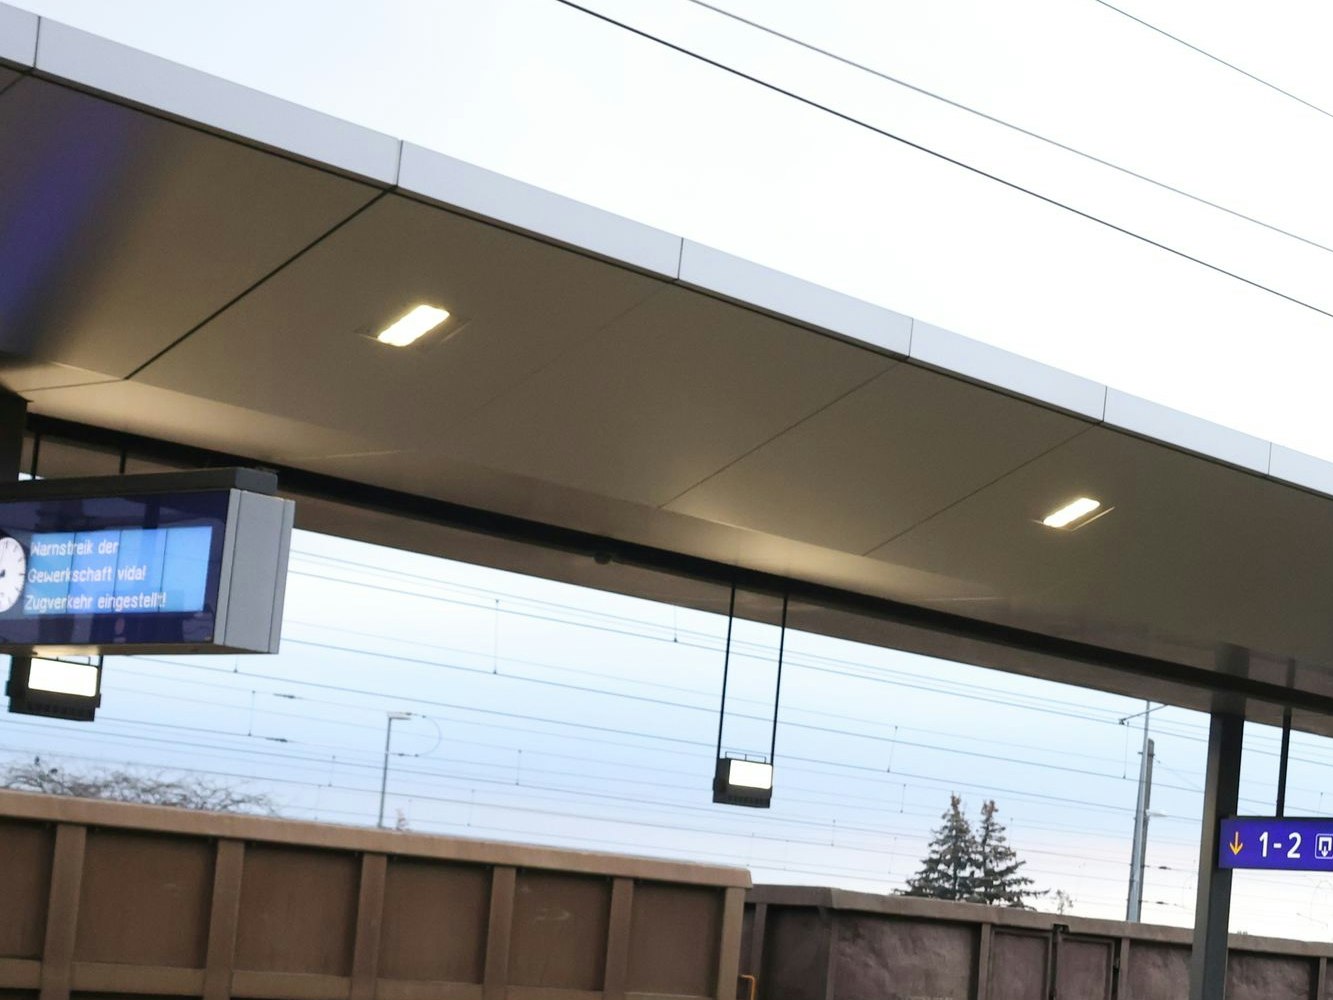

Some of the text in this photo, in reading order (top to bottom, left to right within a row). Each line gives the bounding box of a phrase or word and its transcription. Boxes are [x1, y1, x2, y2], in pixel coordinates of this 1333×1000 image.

[30, 540, 120, 556] Warnstreik der
[27, 564, 146, 583] Gewerkschaft vida!
[24, 592, 167, 612] Zugverkehr eingestellt!
